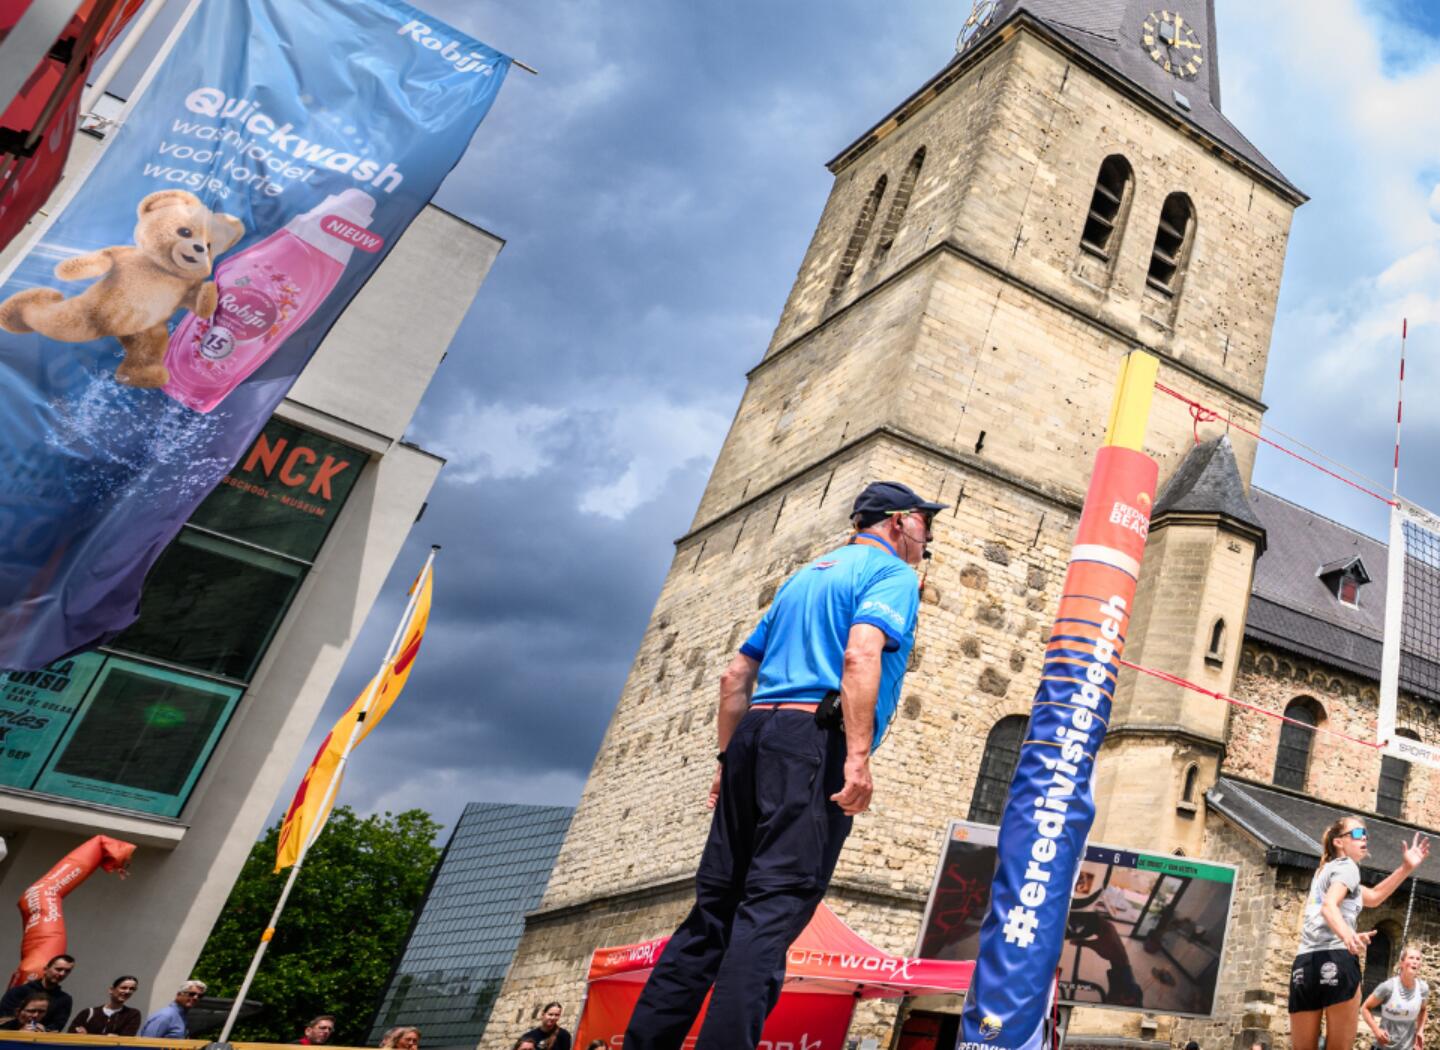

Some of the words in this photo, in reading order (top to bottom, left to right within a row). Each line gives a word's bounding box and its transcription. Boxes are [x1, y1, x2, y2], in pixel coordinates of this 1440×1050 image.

[397, 20, 494, 76] Robijn
[158, 141, 223, 165] voor
[185, 87, 404, 193] Quickwash
[143, 163, 231, 200] wasjes
[326, 219, 380, 249] NIEUW
[219, 293, 267, 329] Robijn
[206, 333, 228, 351] 15
[242, 432, 350, 501] NCK
[279, 495, 326, 518] MUSEUM
[1002, 595, 1127, 948] #eredivisiebeach
[1113, 853, 1121, 864] 6
[604, 941, 661, 965] SPORTWORX
[788, 950, 922, 981] ORTWORX
